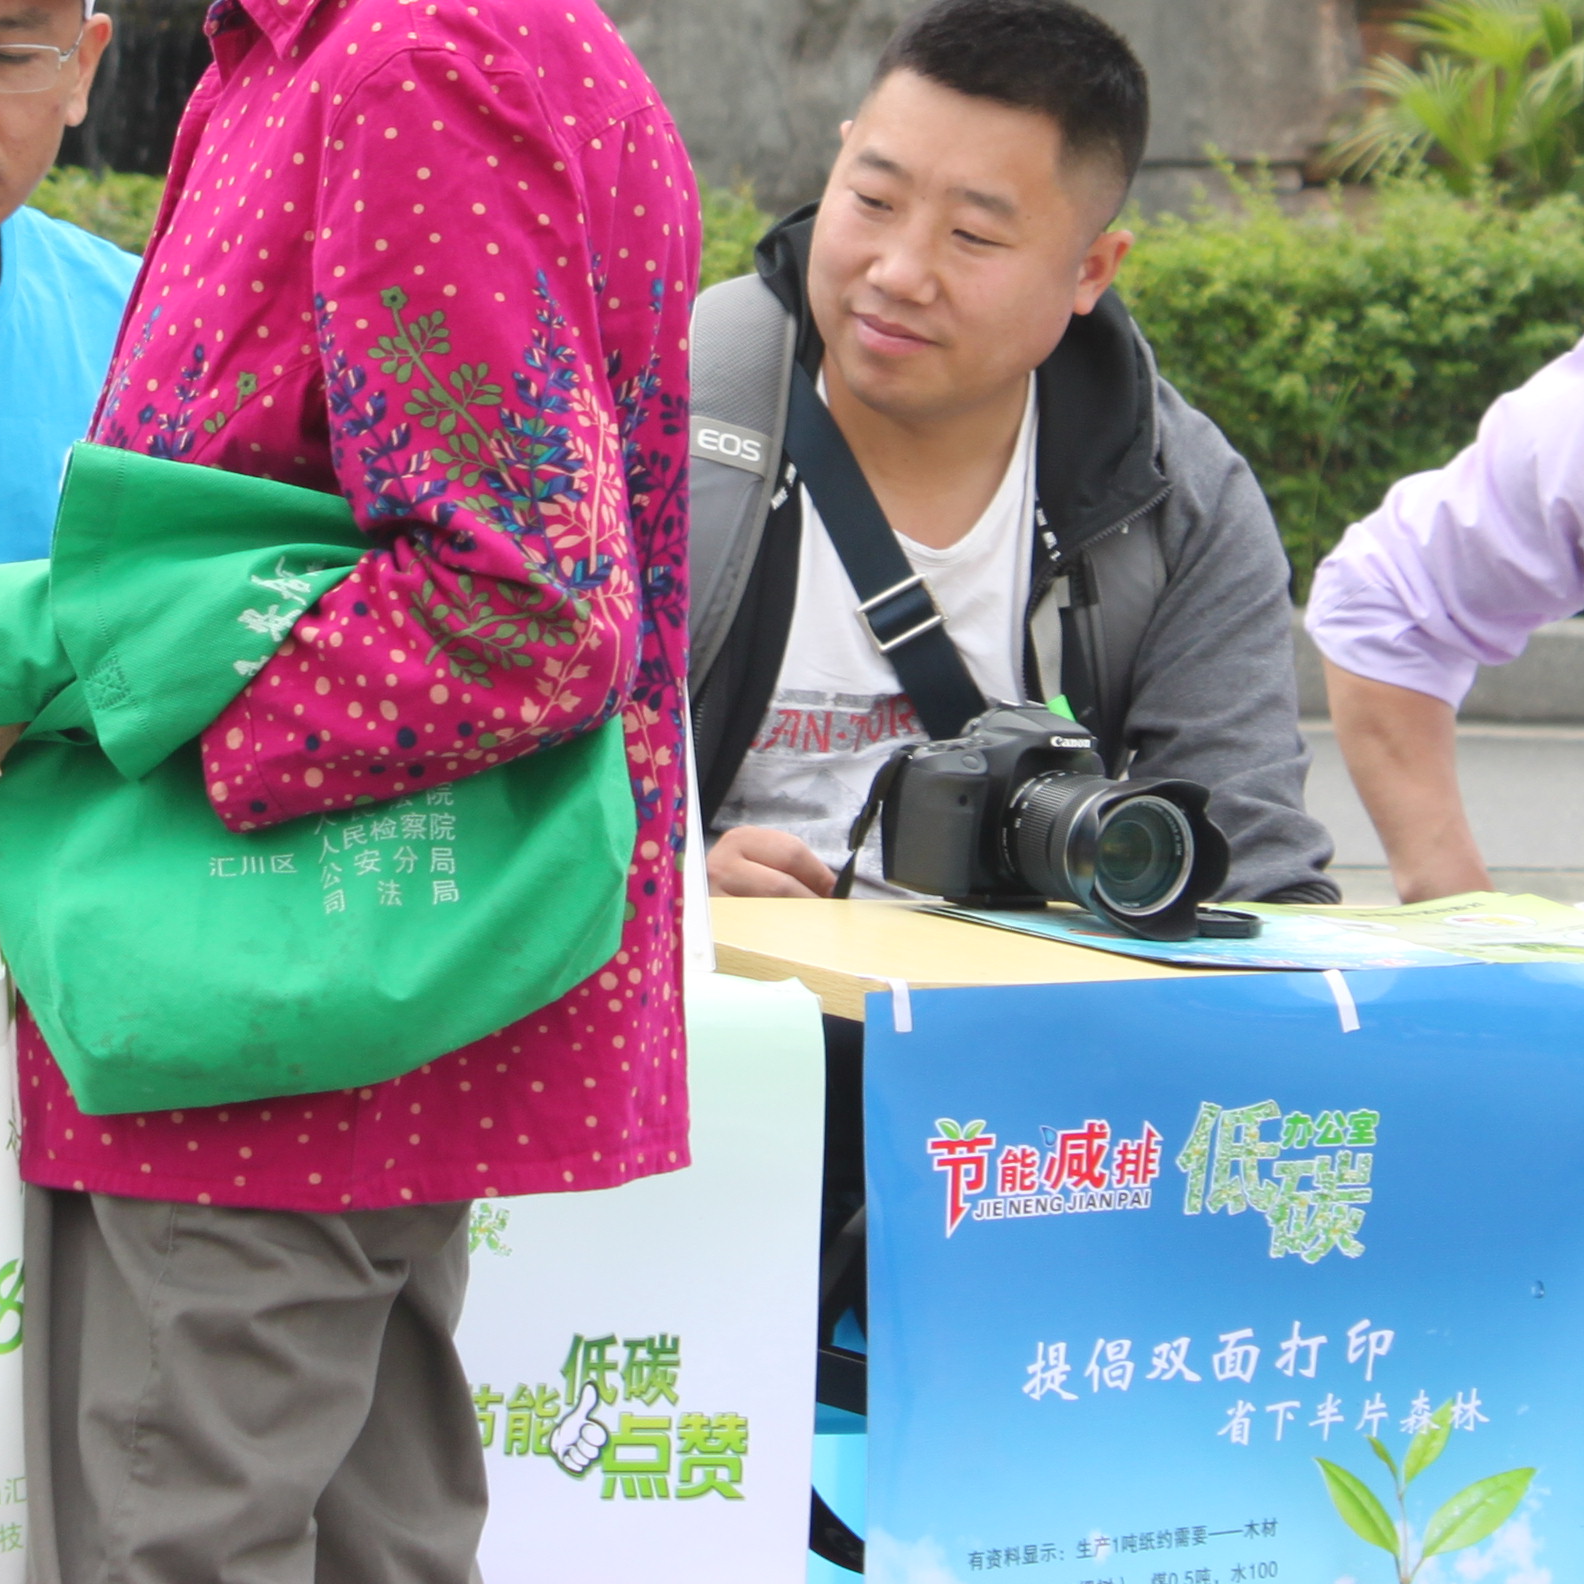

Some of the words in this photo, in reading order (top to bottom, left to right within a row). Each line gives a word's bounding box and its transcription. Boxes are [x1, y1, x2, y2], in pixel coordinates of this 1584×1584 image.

[697, 428, 761, 462] EOS
[1050, 735, 1091, 749] Canon
[318, 812, 456, 864] 人民检察院
[209, 853, 297, 877] 汇川区
[1280, 1109, 1379, 1149] 办公室
[928, 1120, 1162, 1239] 节能减排
[974, 1199, 1004, 1220] JIE
[1008, 1196, 1063, 1217] NENG
[1066, 1192, 1114, 1213] JIAN
[1117, 1190, 1152, 1209] PAI
[560, 1333, 681, 1406] 低碳
[1021, 1319, 1396, 1401] 提倡双面打印
[1217, 1387, 1490, 1446] 省下半片森林
[600, 1412, 749, 1500] 点赞
